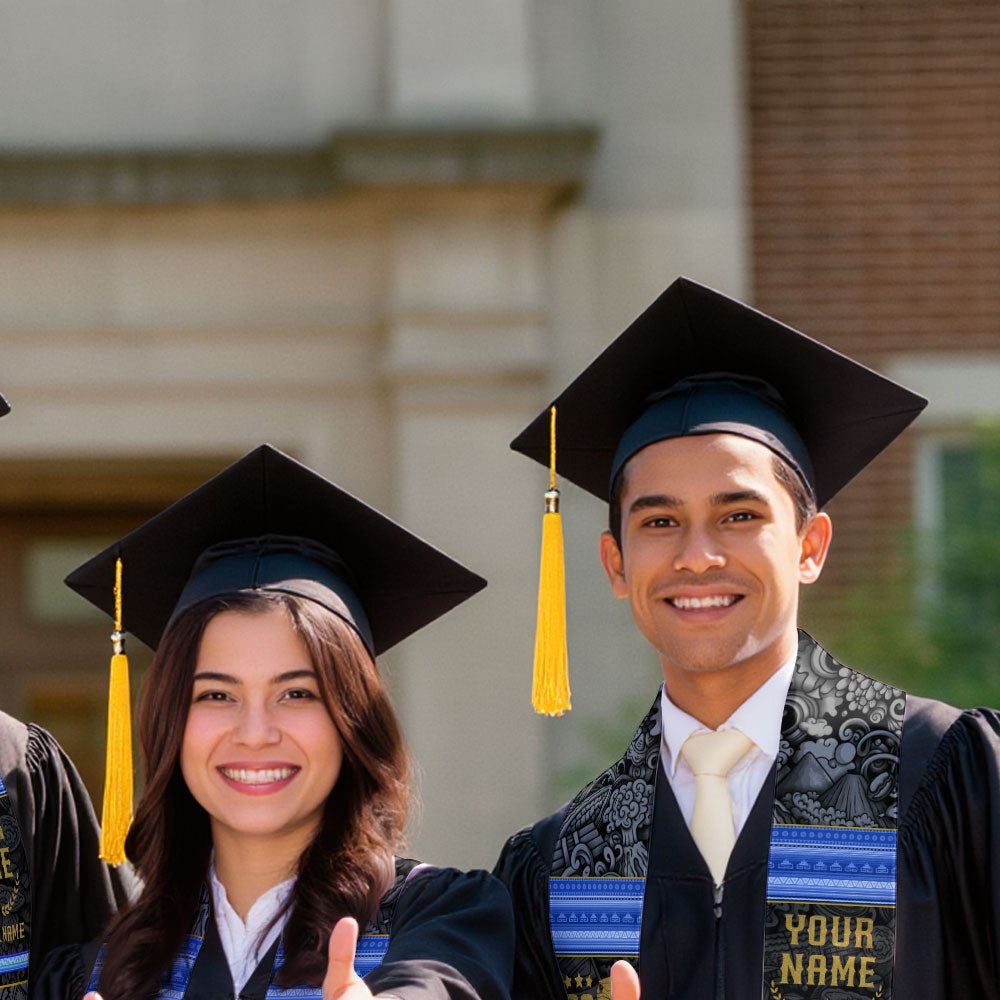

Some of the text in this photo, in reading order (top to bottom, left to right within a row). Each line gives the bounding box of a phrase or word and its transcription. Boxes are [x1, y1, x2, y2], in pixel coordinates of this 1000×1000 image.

[2, 922, 25, 941] NAME
[785, 914, 873, 949] YOUR
[780, 952, 876, 988] NAME
